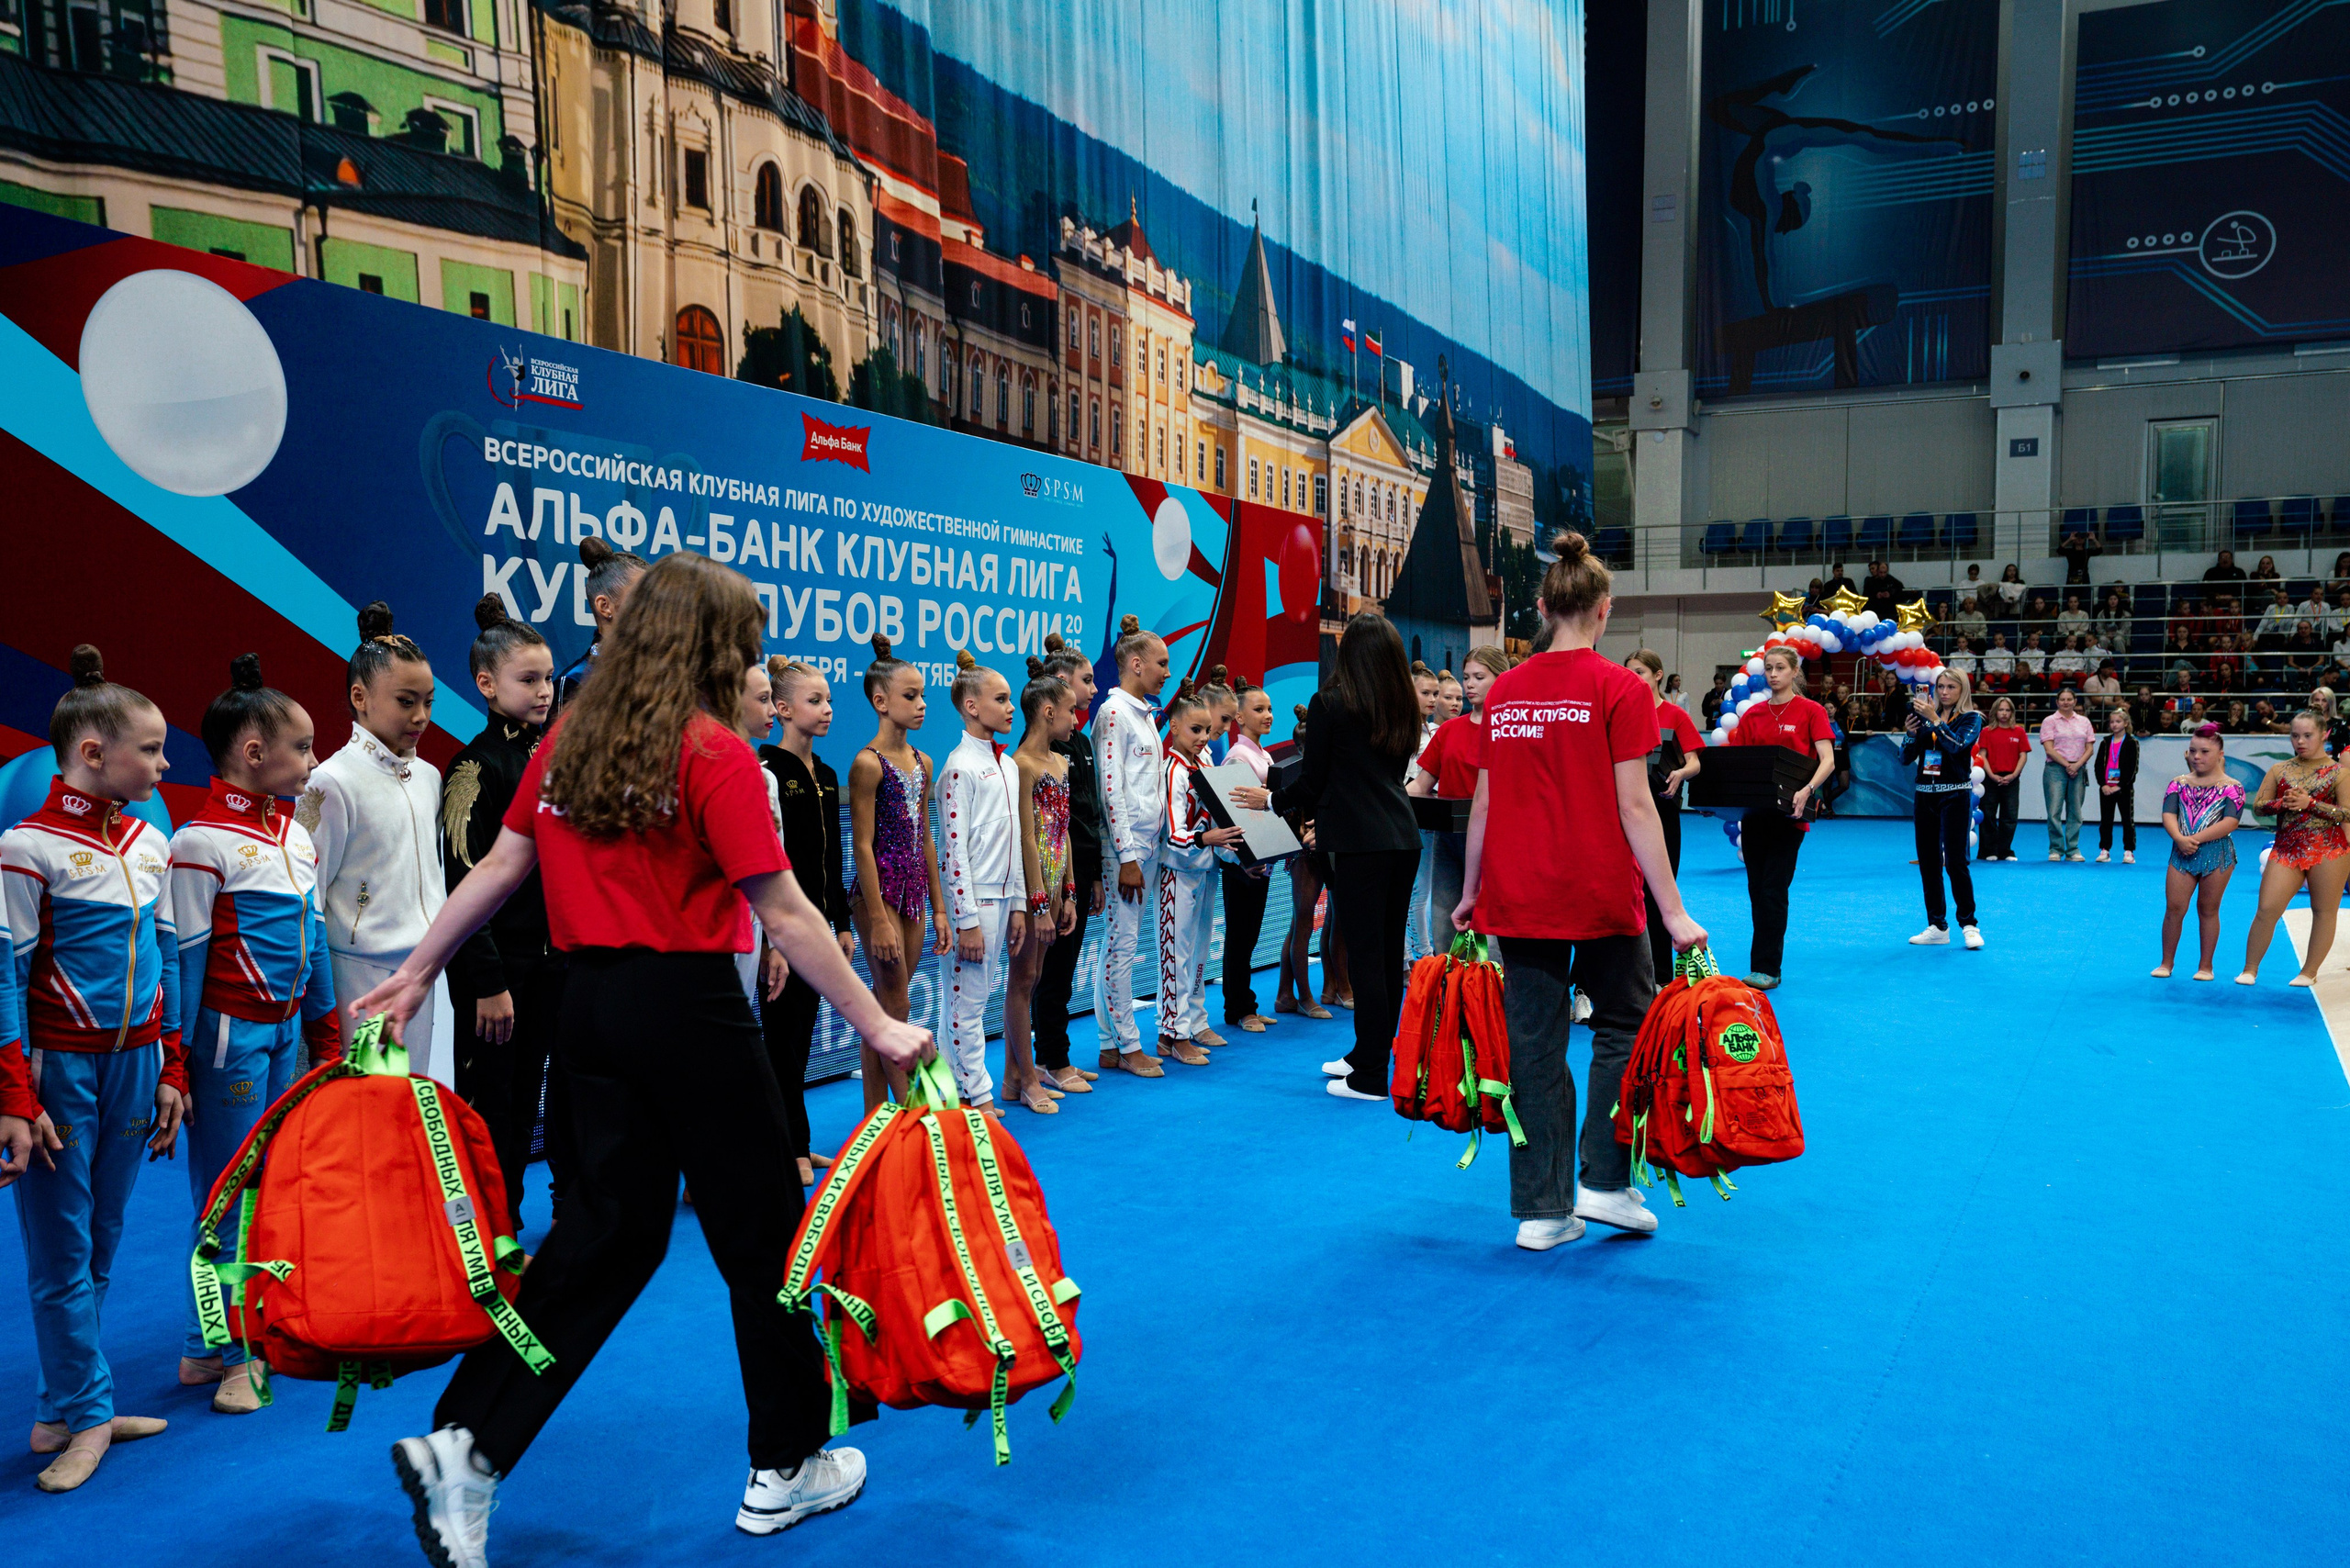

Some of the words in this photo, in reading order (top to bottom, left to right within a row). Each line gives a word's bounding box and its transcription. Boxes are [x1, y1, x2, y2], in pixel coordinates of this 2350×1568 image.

[530, 357, 579, 375] ВСЕРОССИЙСКАЯ
[530, 364, 579, 385] КЛУБНАЯ
[531, 375, 579, 401] ЛИГА
[811, 431, 840, 450] Альфа
[841, 438, 863, 454] Банк
[484, 436, 682, 492] ВСЕРОССИЙСКАЯ
[688, 471, 779, 508] КЛУБНАЯ
[784, 488, 828, 515] ЛИГА
[834, 497, 856, 520] ПО
[861, 500, 1001, 543] ХУДОЖЕСТВЕННОЙ
[1002, 526, 1083, 555] ГИМНАСТИКЕ
[484, 482, 825, 575] АЛЬФА-БАНК
[836, 531, 999, 594] КЛУБНАЯ
[1007, 557, 1083, 604] ЛИГА
[752, 581, 905, 646] ЛУБОВ
[918, 599, 1062, 656] РОССИИ
[1065, 613, 1083, 634] 20
[1491, 708, 1530, 726] КУБОК
[1532, 707, 1591, 723] КЛУБОВ
[1491, 724, 1537, 742] РССИИ
[1192, 963, 1204, 996] RUSSIA
[1723, 1033, 1759, 1044] АЛЬФА
[1728, 1042, 1756, 1053] БАНК
[418, 1084, 464, 1198] СВОБОДНЫХ
[841, 1114, 890, 1174] УМНЫХ
[929, 1121, 951, 1193] УМНЫХ
[830, 1176, 846, 1192] И
[980, 1157, 1003, 1197] ДЛЯ
[943, 1198, 957, 1212] И
[948, 1215, 998, 1336] СВОБОДНЫХ
[1023, 1272, 1038, 1287] И
[195, 1260, 225, 1334] УМНЫХ
